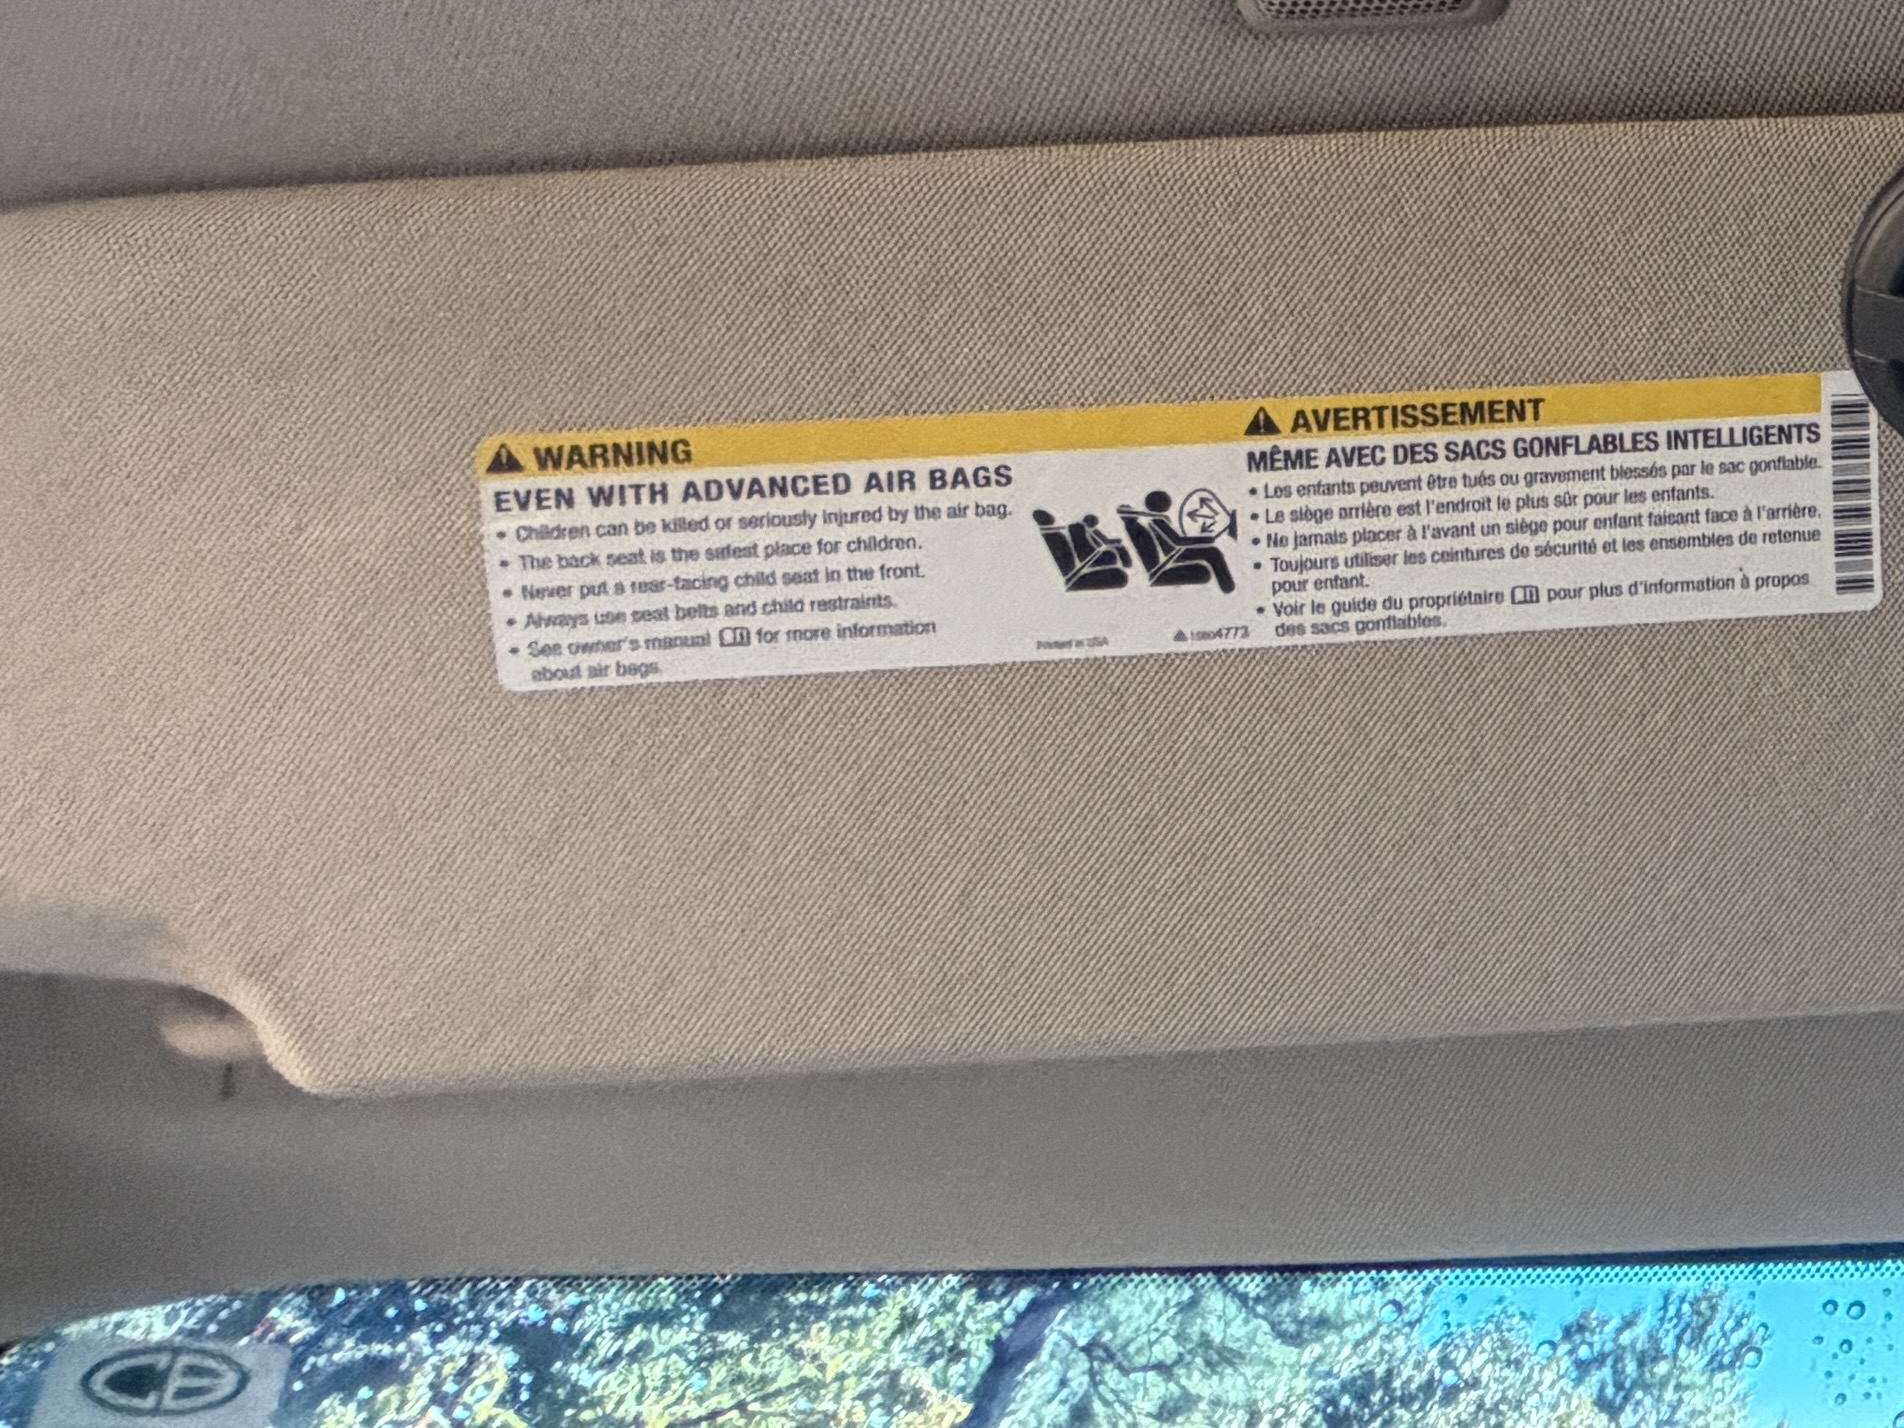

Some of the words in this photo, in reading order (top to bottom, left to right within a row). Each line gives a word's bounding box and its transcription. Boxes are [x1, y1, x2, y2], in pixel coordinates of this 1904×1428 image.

[1291, 398, 1545, 434] AVERTISSEMENT
[533, 438, 691, 472] WARNING
[1246, 442, 1318, 474] MÊME
[1326, 444, 1385, 470] AVEC
[1392, 441, 1438, 466] DES
[1444, 438, 1506, 463] SACS
[1512, 430, 1659, 460] GONFLABLES
[1666, 421, 1820, 452] INTELLIGENTS
[493, 486, 574, 514] EVEN
[587, 481, 668, 509] WITH
[682, 472, 851, 505] ADVANCED
[864, 469, 916, 495] AIR
[928, 464, 1012, 492] BAGS
[1263, 483, 1292, 500] Les
[1296, 479, 1355, 499] enfants
[1359, 475, 1422, 499] peuvent
[1499, 473, 1519, 487] ou
[1523, 465, 1605, 490] gravement
[1671, 463, 1695, 481] par
[1700, 459, 1714, 476] le
[515, 521, 590, 542] Children
[595, 523, 628, 539] can
[633, 518, 656, 537] be
[661, 516, 710, 535] killed
[714, 518, 732, 533] or
[737, 510, 816, 535] seriously
[822, 507, 882, 531] injured
[887, 506, 908, 528] by
[913, 504, 941, 523] the
[946, 503, 969, 522] air
[974, 501, 1013, 524] bag.
[1264, 507, 1284, 524] Le
[1396, 499, 1421, 517] est
[1425, 495, 1491, 515] l'endroit
[1496, 494, 1510, 512] le
[1515, 492, 1549, 514] plus
[1583, 491, 1617, 510] pour
[1623, 487, 1647, 504] les
[1651, 483, 1715, 503] enfants.
[1266, 530, 1288, 548] Ne
[1293, 527, 1347, 550] jamais
[1352, 525, 1401, 547] placer
[1421, 521, 1475, 540] l'avant
[1480, 522, 1500, 537] un
[1552, 518, 1587, 536] pour
[1593, 512, 1643, 531] enfant
[1647, 509, 1700, 528] faisant
[1704, 507, 1738, 525] face
[519, 552, 552, 571] The
[556, 550, 600, 569] back
[606, 547, 645, 567] seat
[649, 546, 665, 565] is
[670, 545, 700, 564] the
[704, 542, 758, 562] safest
[763, 539, 811, 563] place
[816, 538, 840, 556] for
[846, 534, 924, 555] children.
[1270, 552, 1339, 576] Toujours
[1343, 549, 1396, 568] utiliser
[1402, 548, 1426, 565] les
[1430, 543, 1505, 564] ceintures
[1509, 542, 1529, 559] de
[1601, 537, 1617, 554] et
[1621, 535, 1645, 553] les
[1648, 530, 1733, 551] ensembles
[1738, 529, 1757, 547] de
[1761, 526, 1821, 545] retenue
[520, 580, 572, 600] Never
[579, 578, 608, 600] put
[613, 580, 625, 595] a
[733, 569, 776, 589] child
[781, 567, 819, 586] seat
[824, 566, 841, 584] in
[846, 564, 874, 583] the
[1271, 579, 1308, 597] pour
[1273, 599, 1304, 617] Voir
[1310, 598, 1325, 615] le
[1331, 595, 1377, 617] guide
[1382, 594, 1403, 611] du
[1546, 586, 1582, 605] pour
[1588, 581, 1623, 603] plus
[1754, 573, 1810, 593] propos
[524, 608, 588, 633] Always
[593, 609, 626, 625] use
[630, 604, 669, 623] seat
[674, 601, 718, 621] belts
[723, 599, 757, 618] and
[761, 597, 804, 616] child
[1274, 620, 1306, 638] des
[1310, 620, 1349, 636] sacs
[527, 638, 562, 657] See
[567, 634, 640, 655] owner's
[644, 630, 711, 651] manual
[755, 626, 779, 645] for
[785, 626, 831, 643] more
[836, 618, 936, 640] information
[530, 662, 582, 682] about
[586, 661, 609, 680] air
